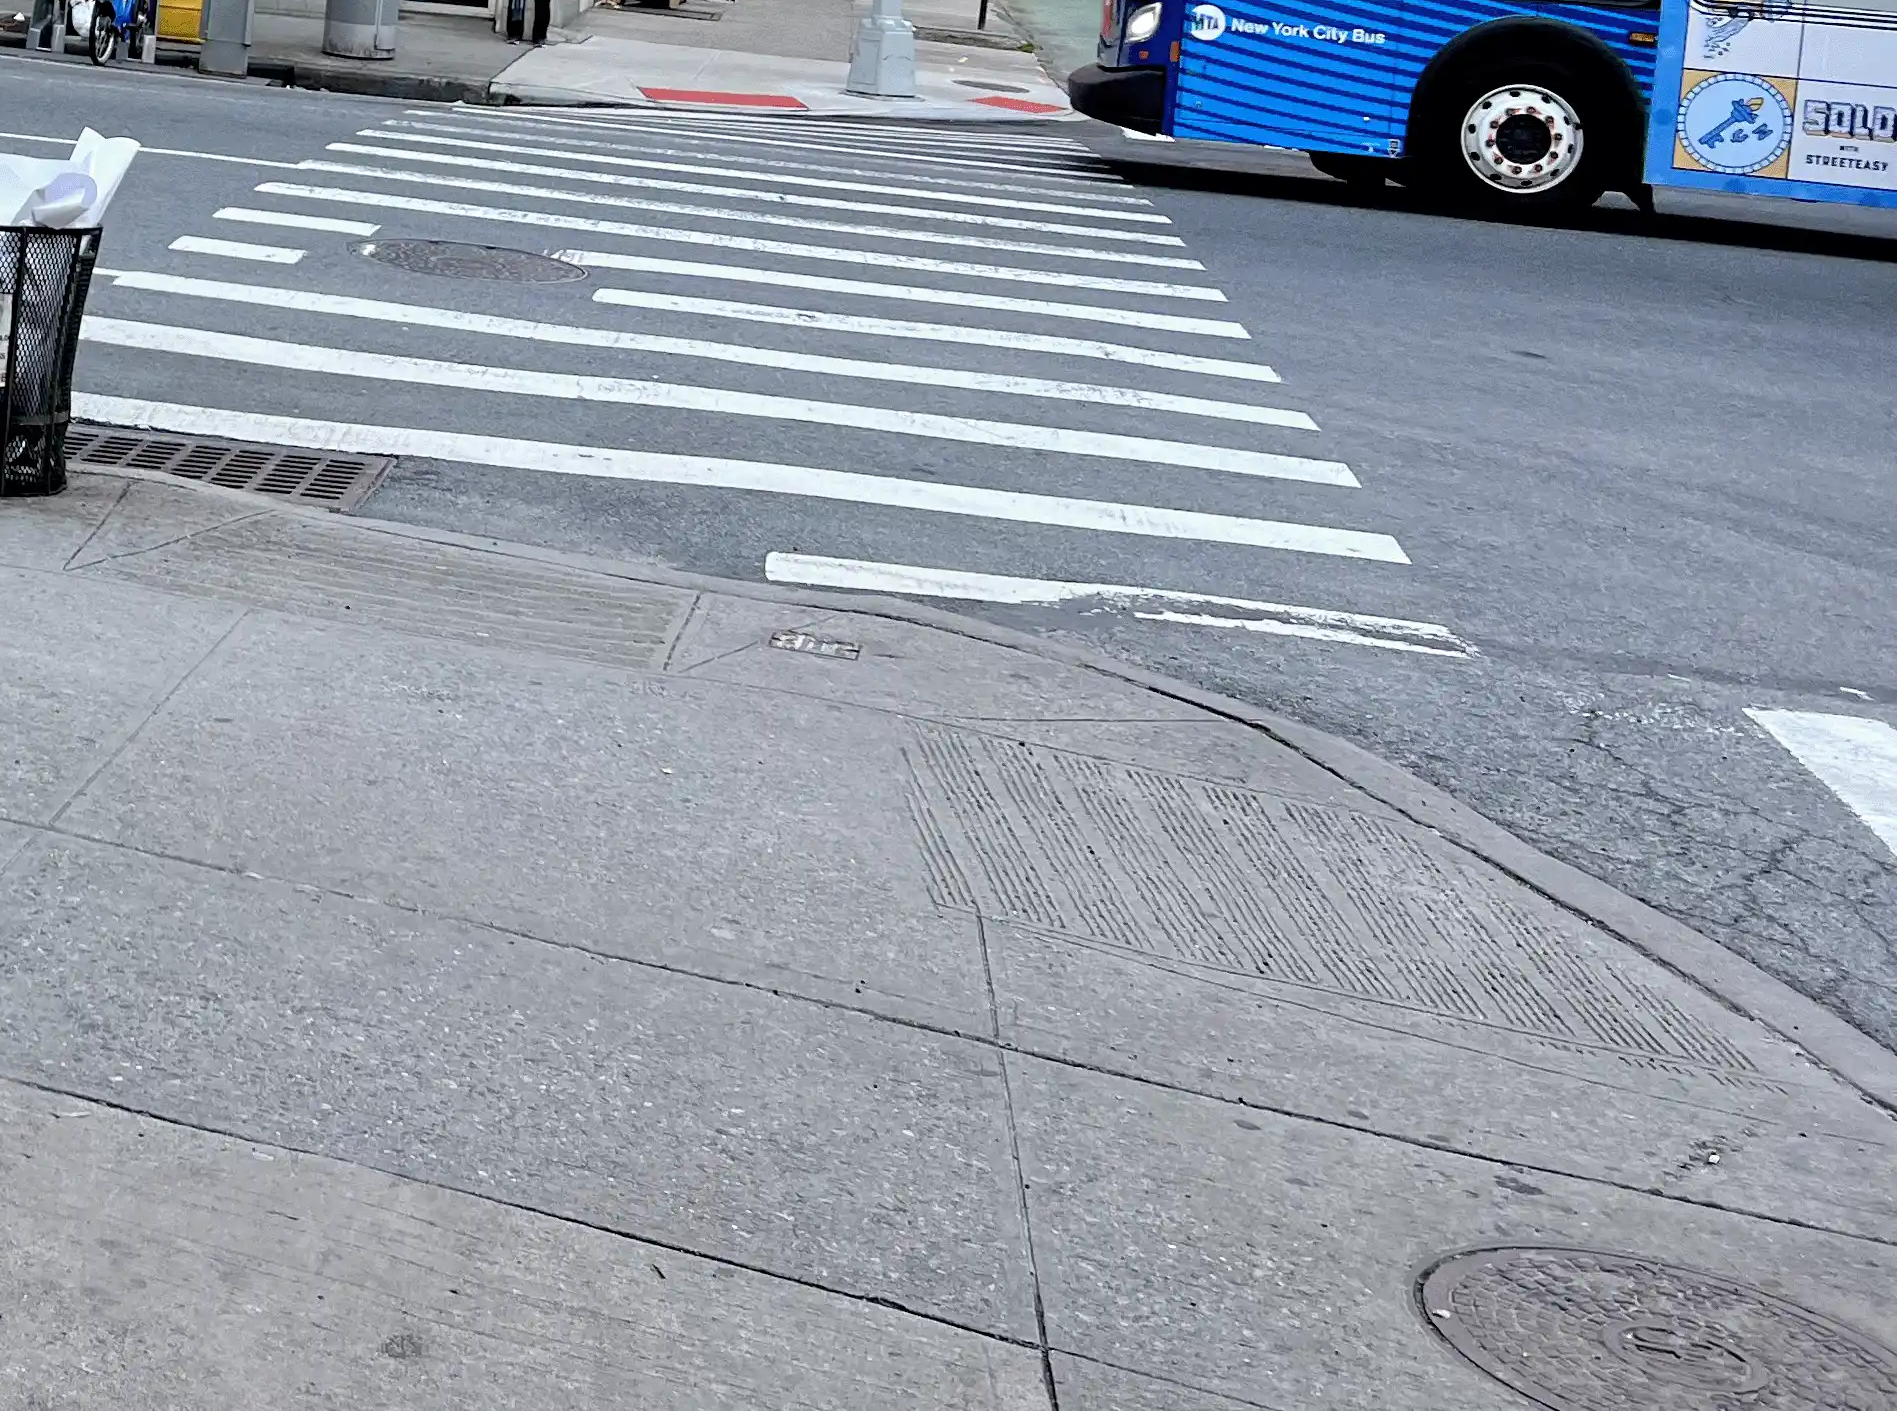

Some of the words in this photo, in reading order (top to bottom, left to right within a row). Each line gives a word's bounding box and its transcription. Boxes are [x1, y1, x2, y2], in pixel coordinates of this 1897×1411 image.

[1192, 14, 1220, 32] MTA
[1230, 18, 1269, 35] New
[1271, 21, 1309, 39] York
[1313, 25, 1348, 44] City
[1352, 28, 1386, 45] Bus
